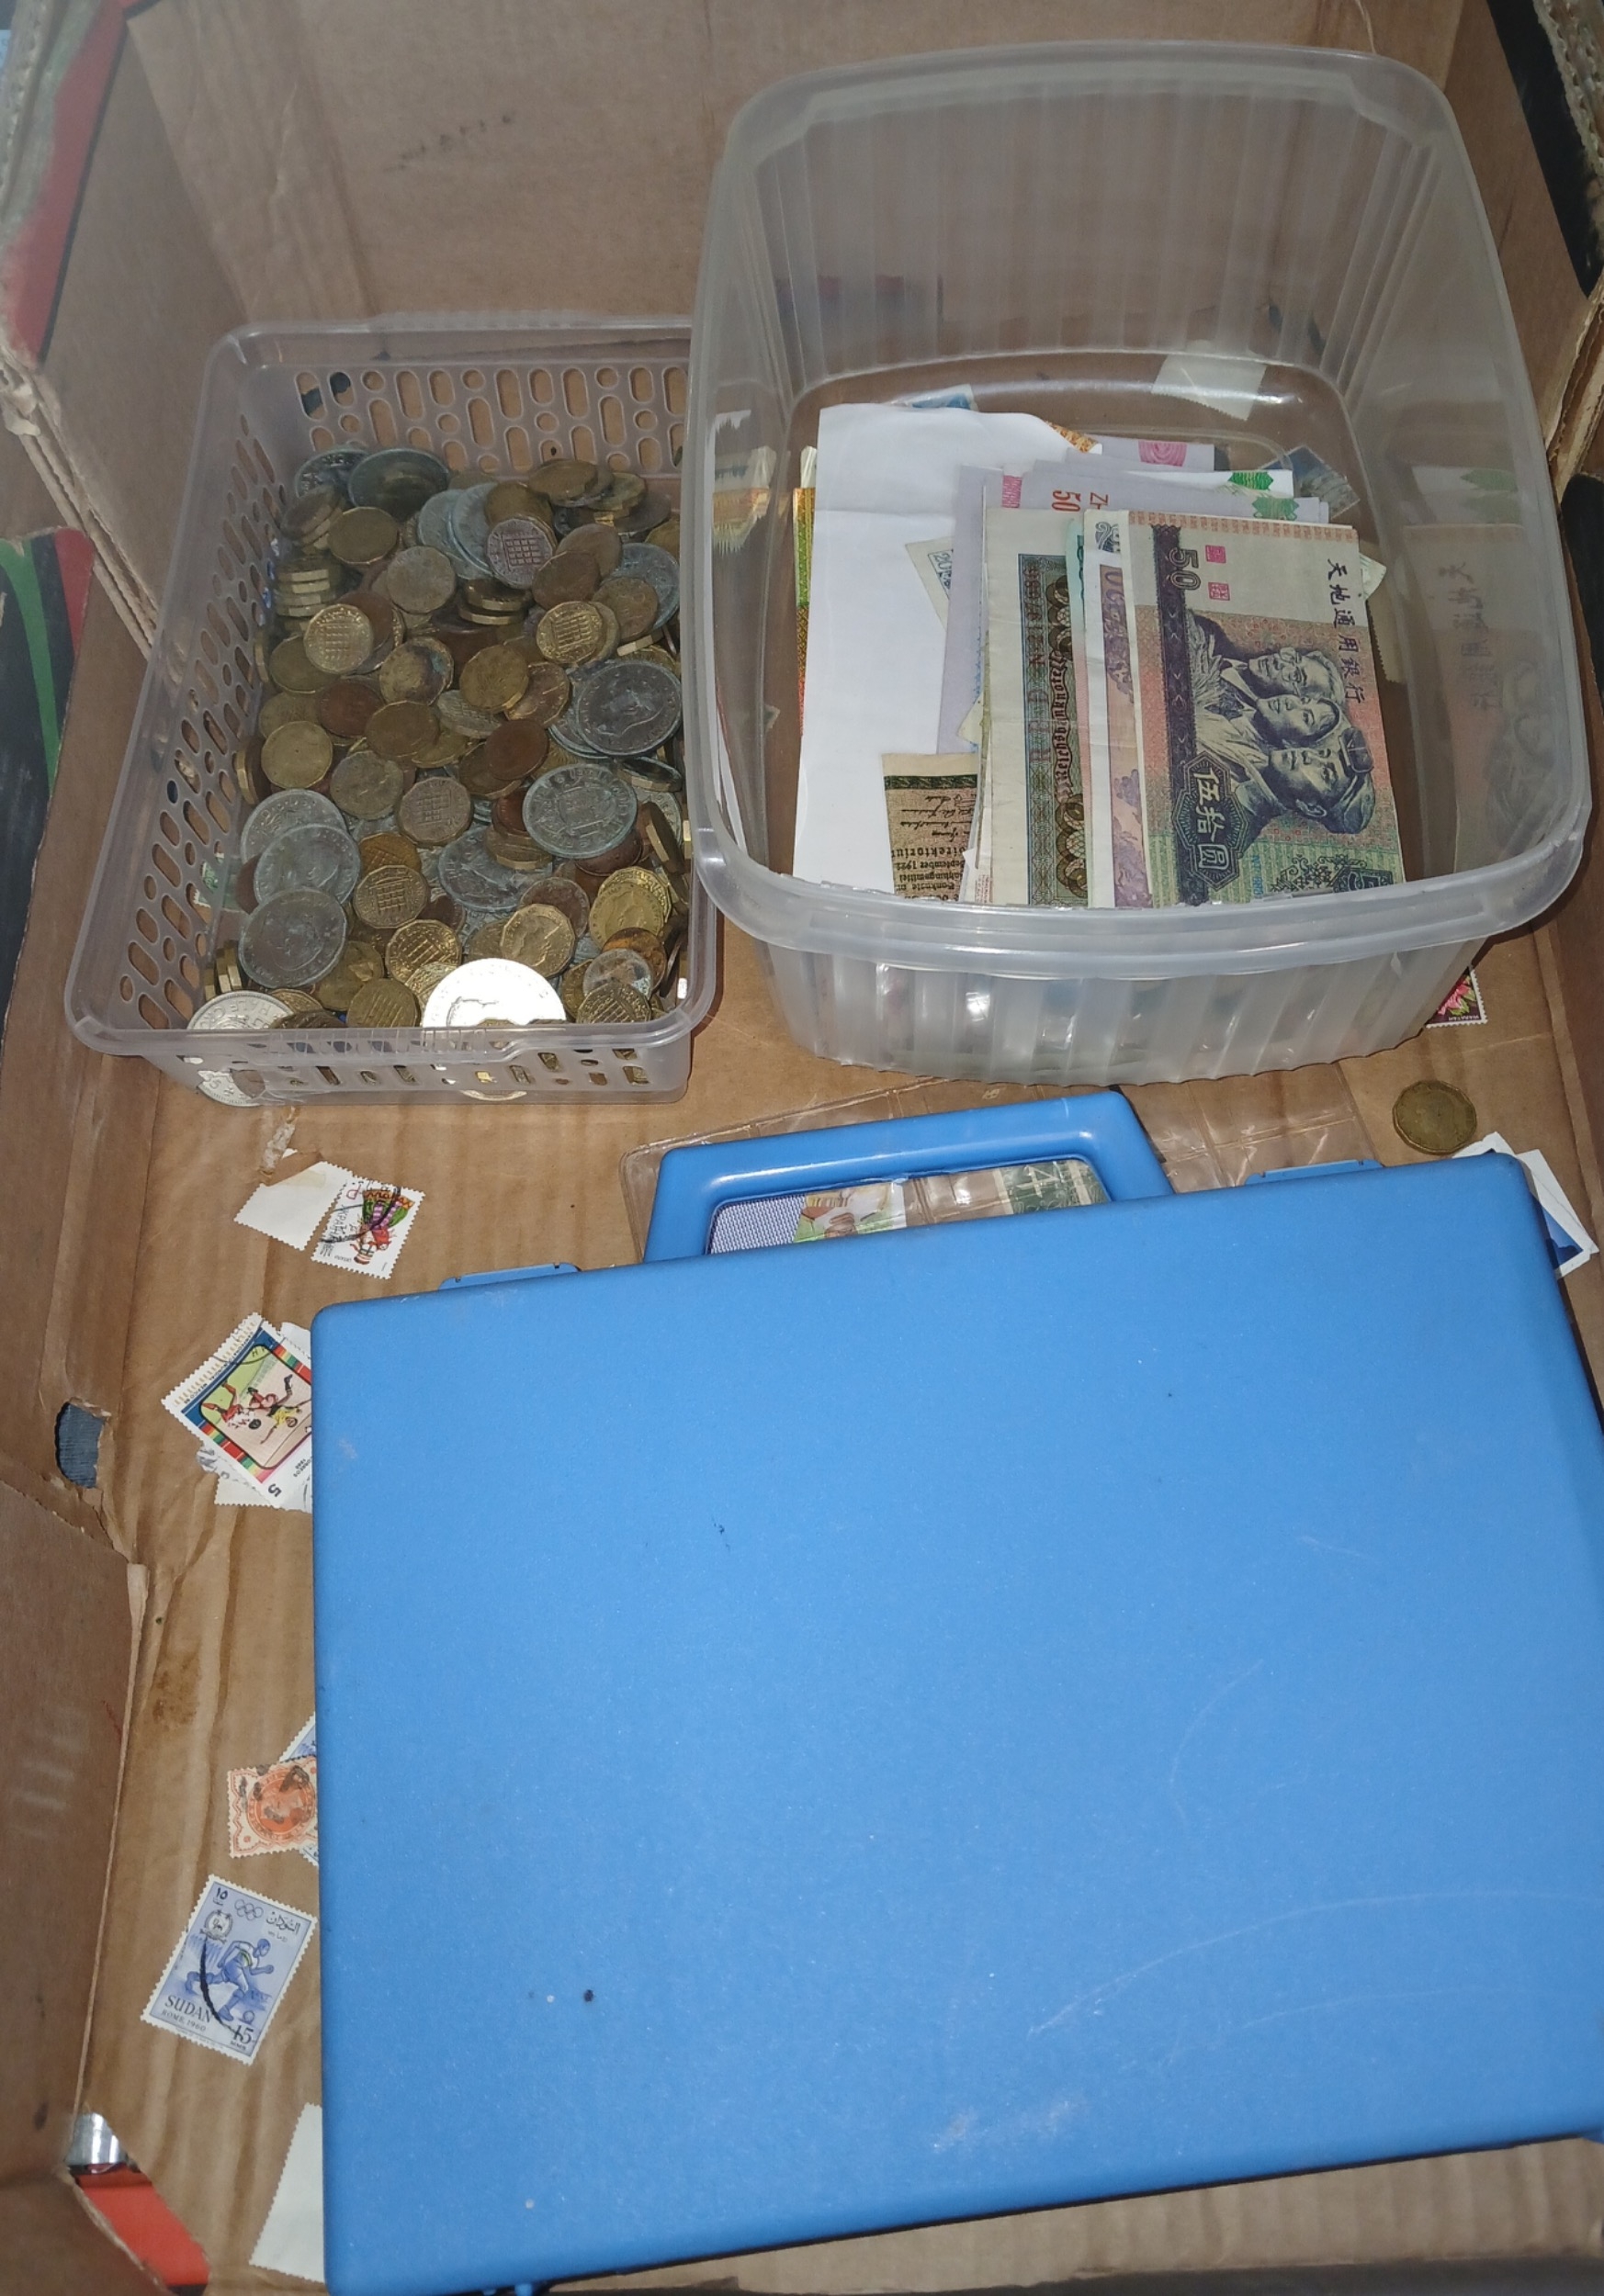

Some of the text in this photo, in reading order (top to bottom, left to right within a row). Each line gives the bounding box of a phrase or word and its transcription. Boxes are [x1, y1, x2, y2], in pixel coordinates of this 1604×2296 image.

[1051, 490, 1081, 512] 50
[1168, 546, 1202, 591] 50
[1326, 557, 1366, 705] 天地通用銀行
[1192, 769, 1230, 872] 伍拾圆
[266, 1482, 282, 1499] 5
[165, 1995, 213, 2023] SUDAN
[187, 2020, 207, 2032] 1960
[233, 2025, 254, 2044] 15
